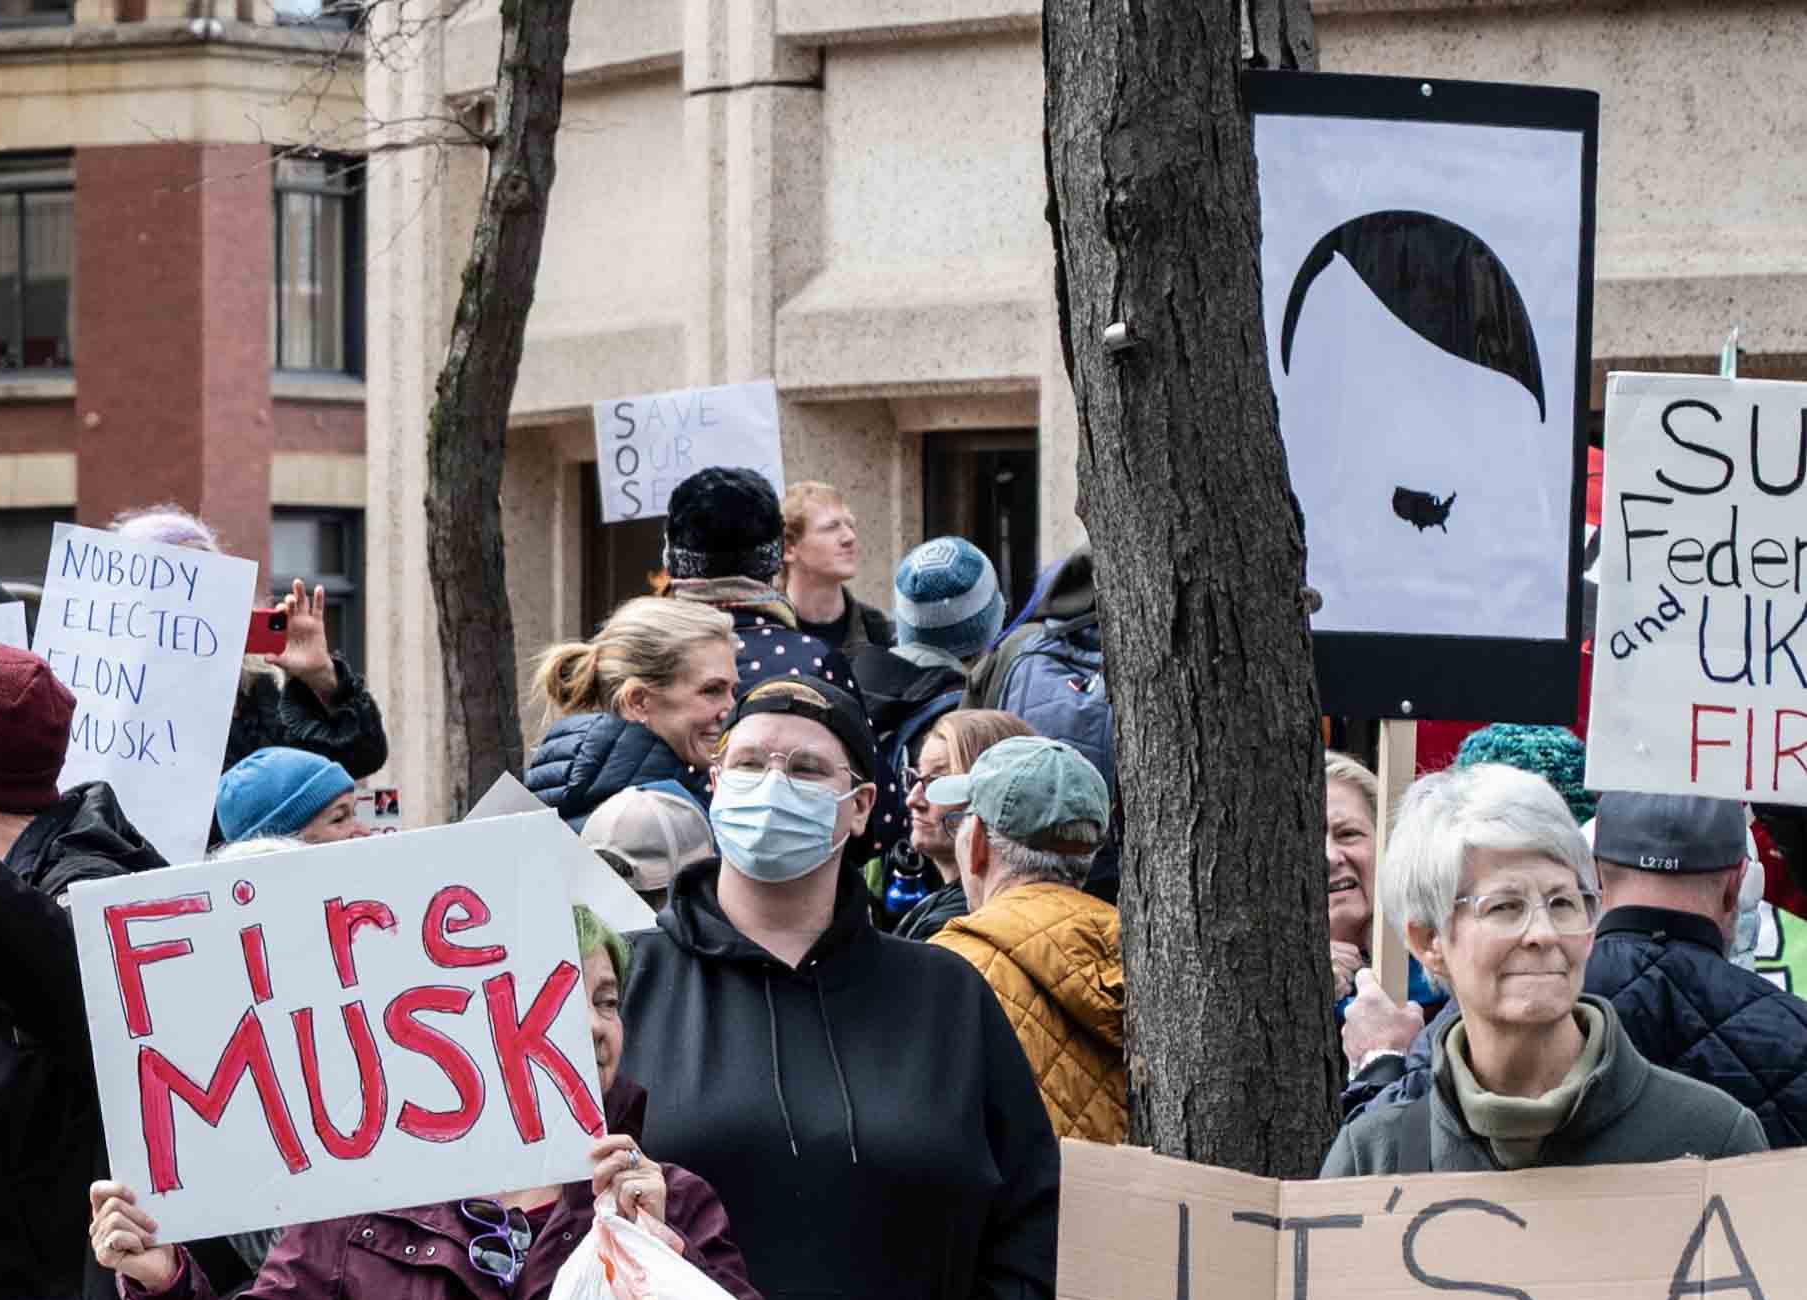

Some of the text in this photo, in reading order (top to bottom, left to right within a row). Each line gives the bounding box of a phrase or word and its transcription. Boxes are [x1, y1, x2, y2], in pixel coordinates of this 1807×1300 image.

[614, 396, 720, 440] SAVE
[616, 434, 694, 477] OUR
[61, 540, 199, 600] NOBODY
[63, 598, 218, 657] ELECTED
[1610, 584, 1686, 660] and
[104, 879, 508, 1039] Fire
[137, 960, 607, 1195] MUSK
